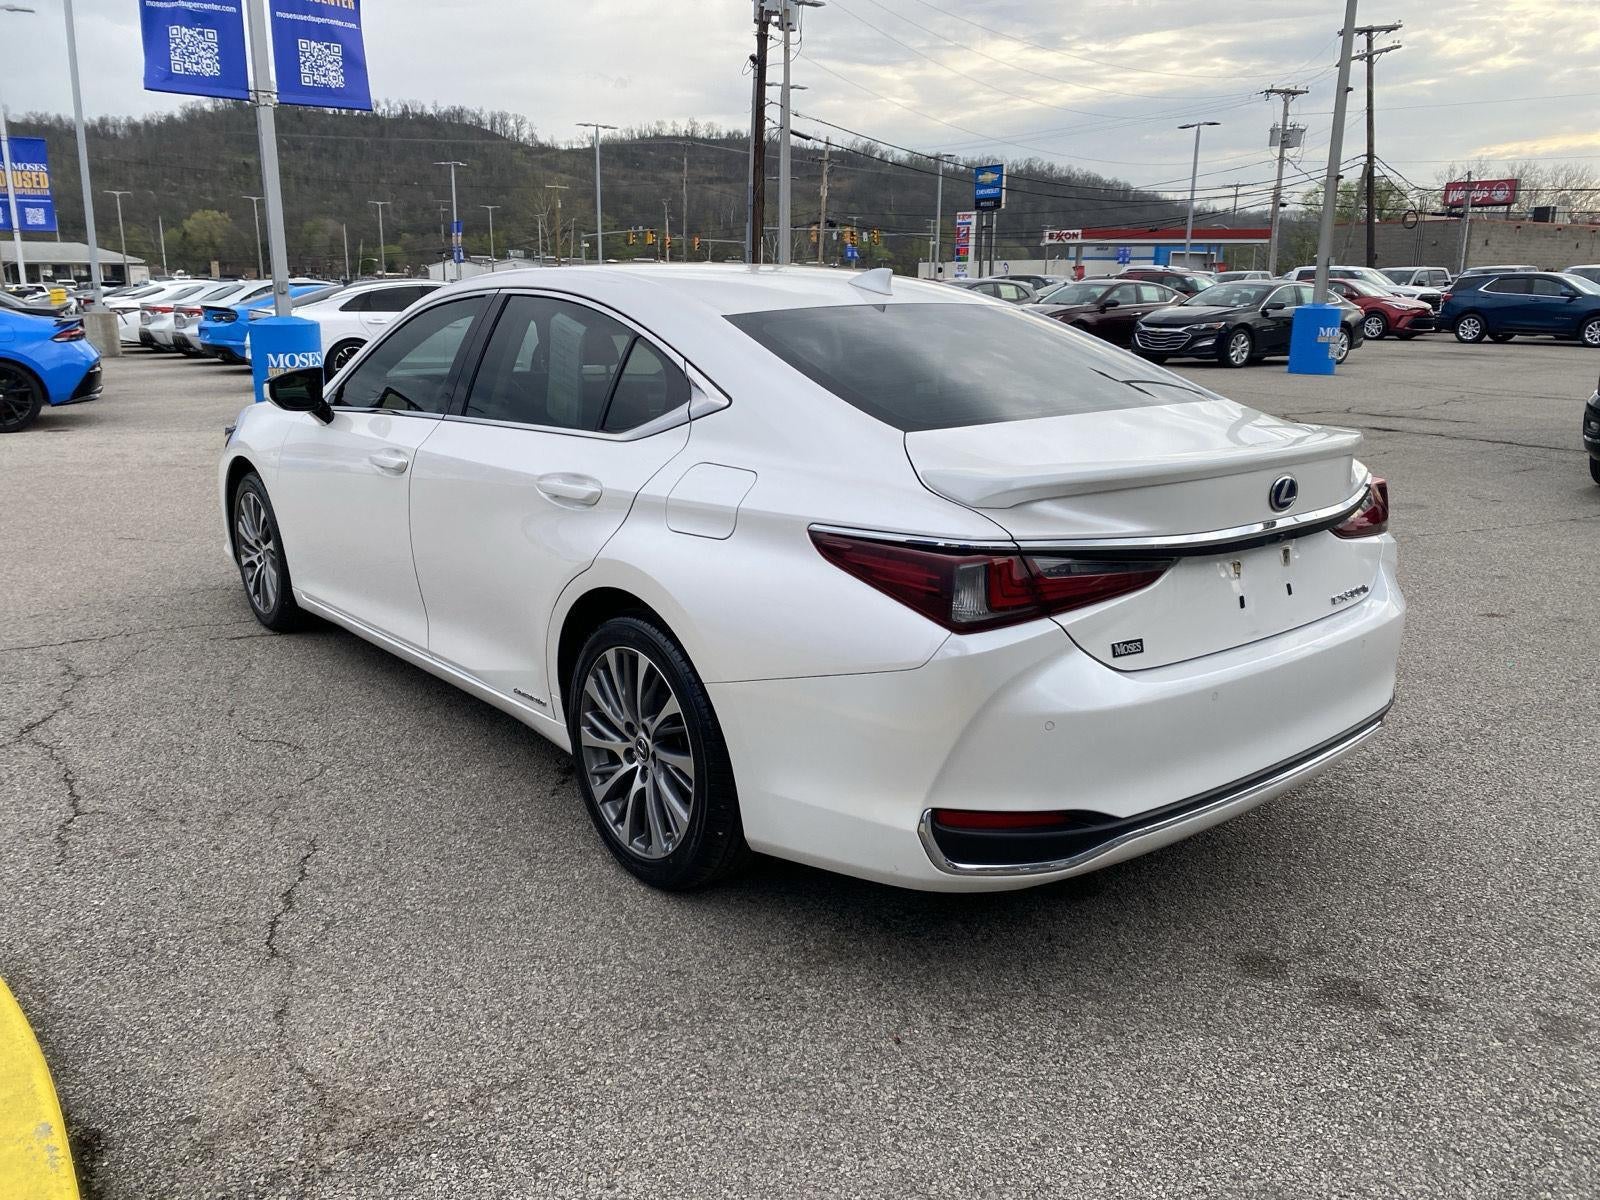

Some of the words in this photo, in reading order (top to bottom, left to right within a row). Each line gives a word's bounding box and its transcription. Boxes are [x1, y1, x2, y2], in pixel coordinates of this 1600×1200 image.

[11, 162, 48, 171] MOSES
[12, 171, 50, 189] USED
[1448, 183, 1490, 203] Wedy's
[1048, 231, 1080, 242] EXXON
[267, 352, 322, 368] MOSES
